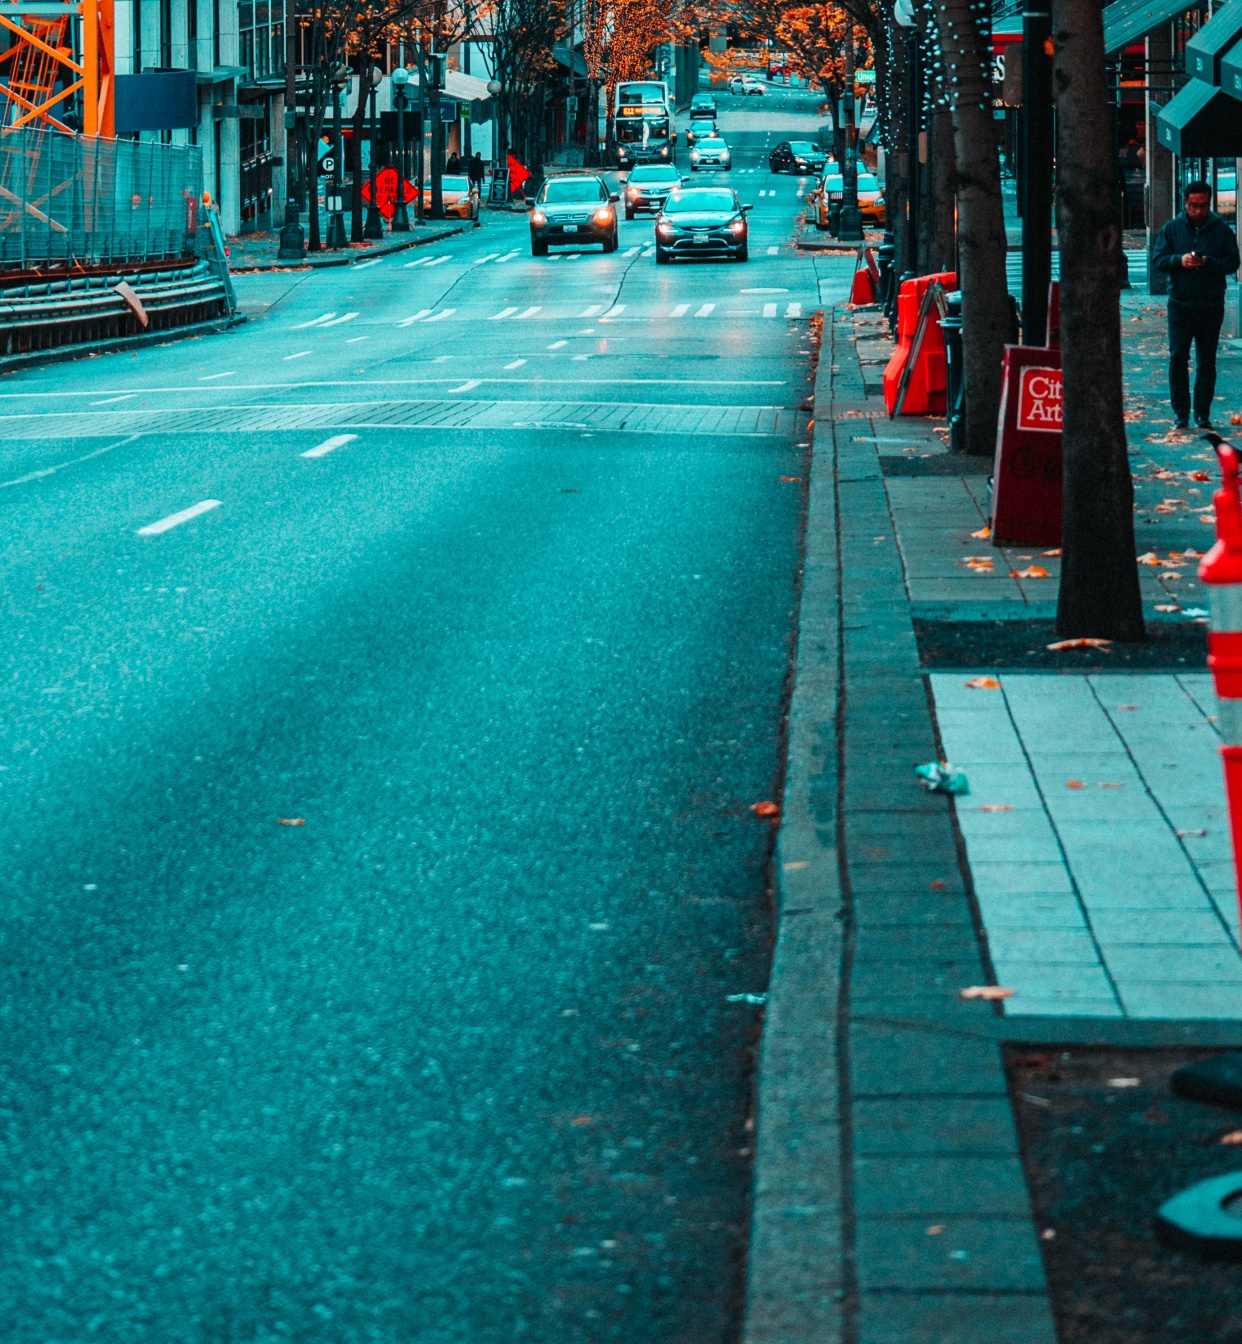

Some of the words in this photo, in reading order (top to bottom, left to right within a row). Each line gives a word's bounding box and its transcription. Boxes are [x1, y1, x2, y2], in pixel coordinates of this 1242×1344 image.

[384, 177, 395, 185] BE
[1028, 376, 1062, 399] Cit
[1026, 399, 1063, 422] Art
